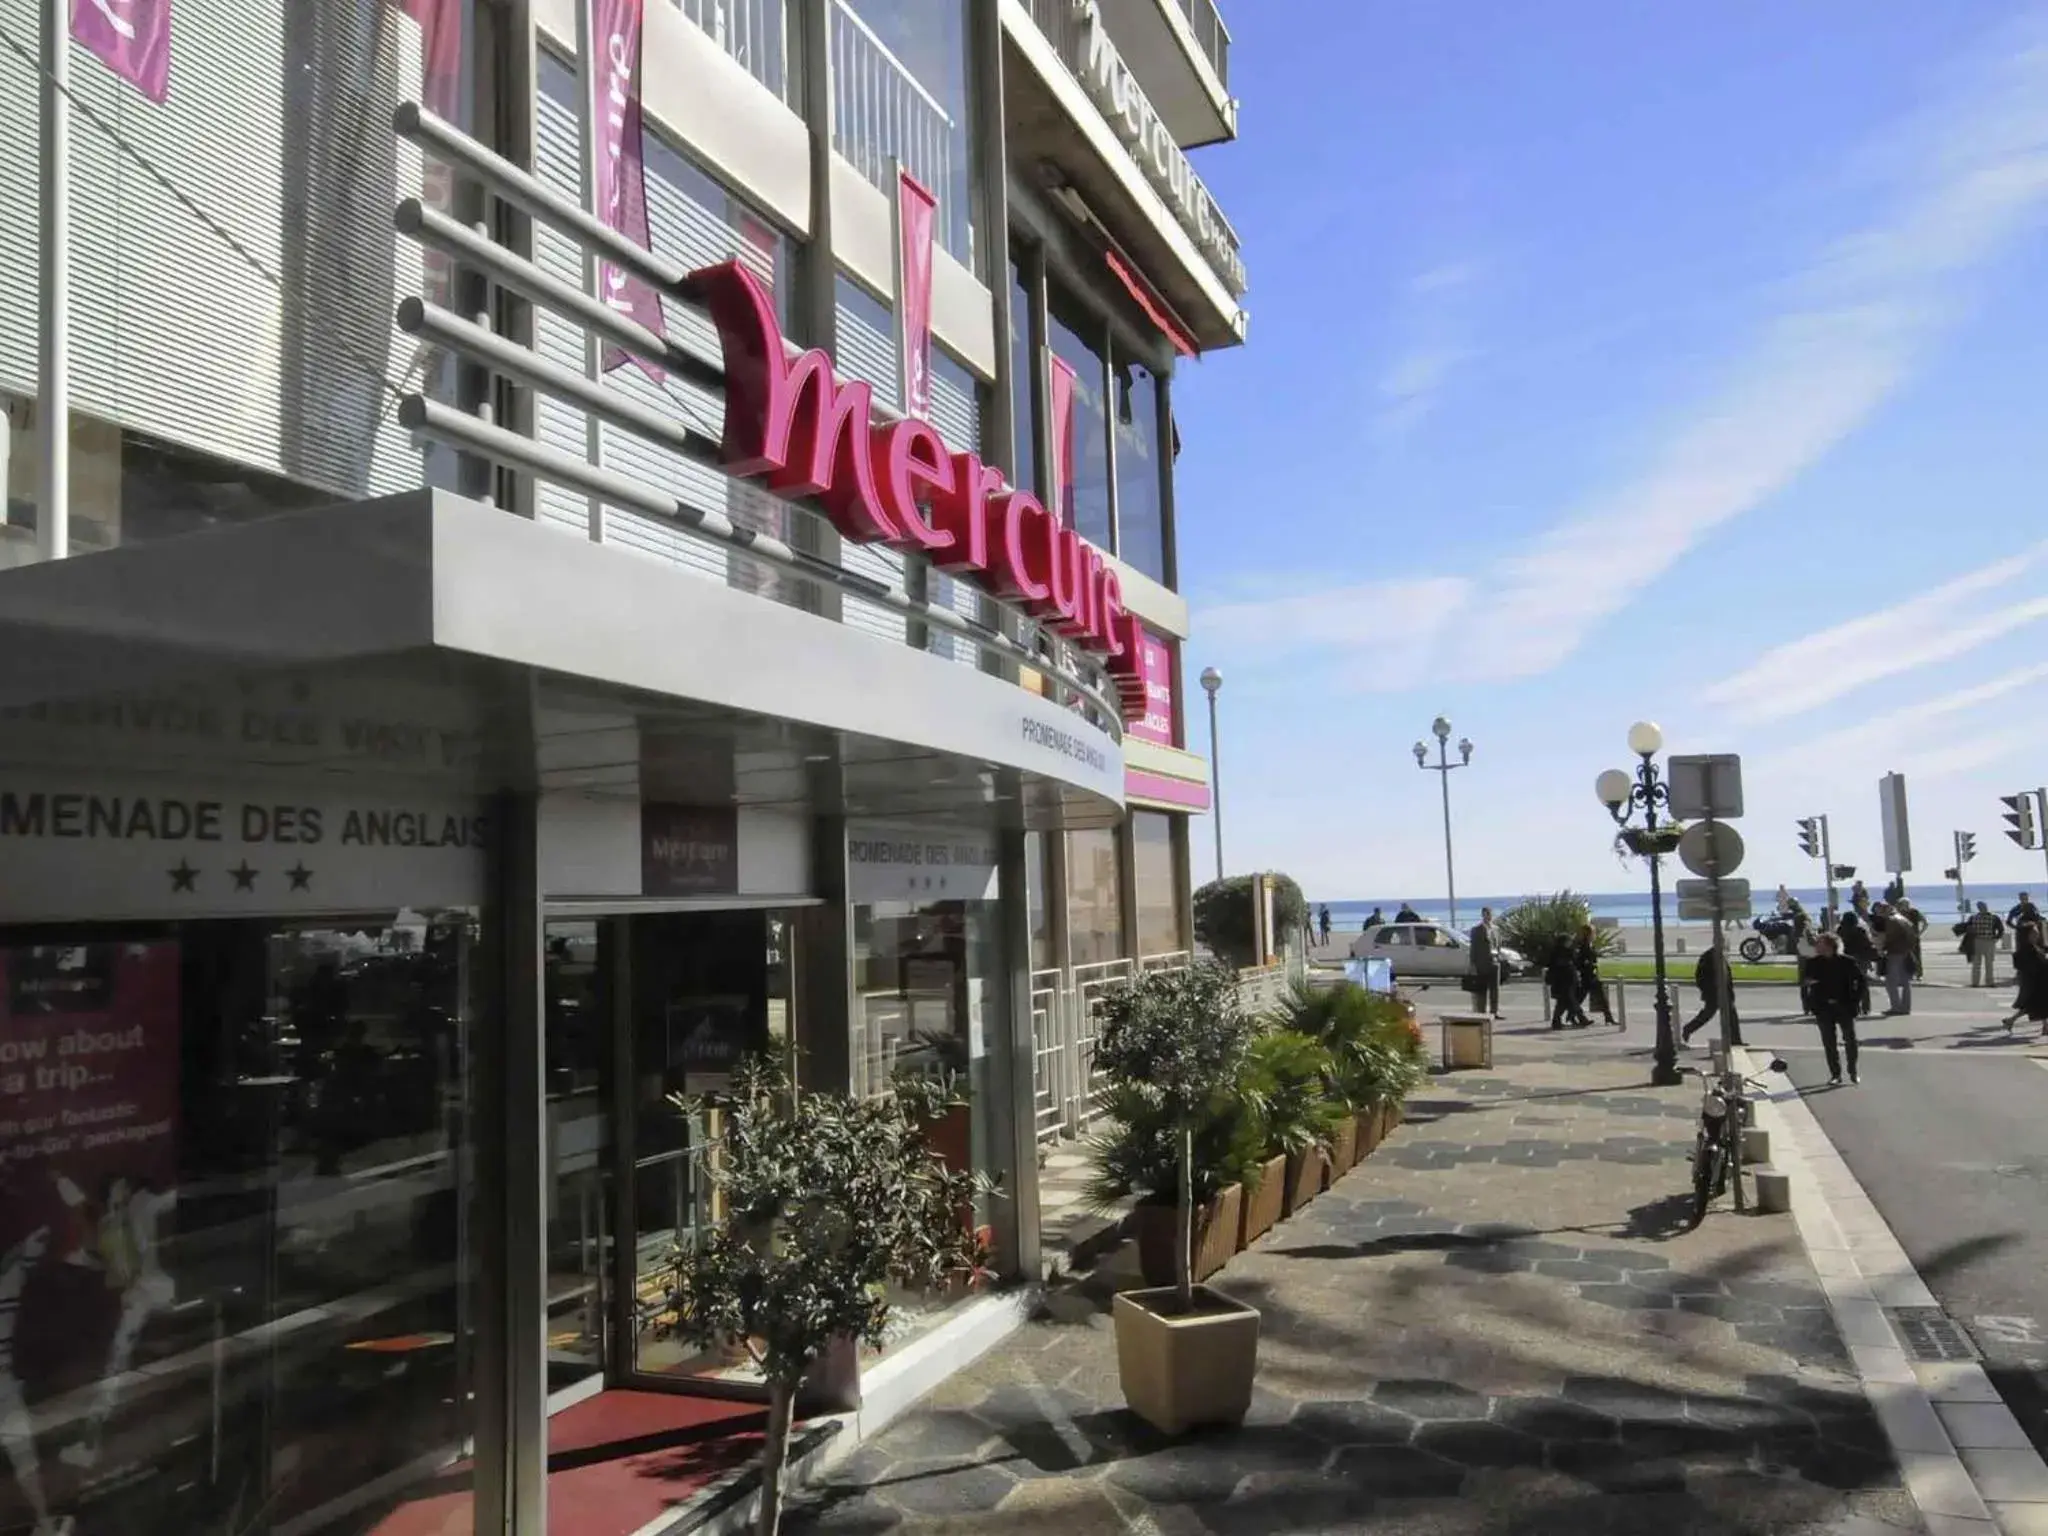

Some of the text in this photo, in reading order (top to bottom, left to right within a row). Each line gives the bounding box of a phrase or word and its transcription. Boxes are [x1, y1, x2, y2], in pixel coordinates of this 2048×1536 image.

[240, 804, 325, 845] DES
[341, 808, 489, 849] ANGLAIS
[848, 839, 922, 865] ROMENADE
[0, 1023, 145, 1063] ow about
[3, 1061, 114, 1094] a trip...
[61, 1102, 138, 1127] fantastic
